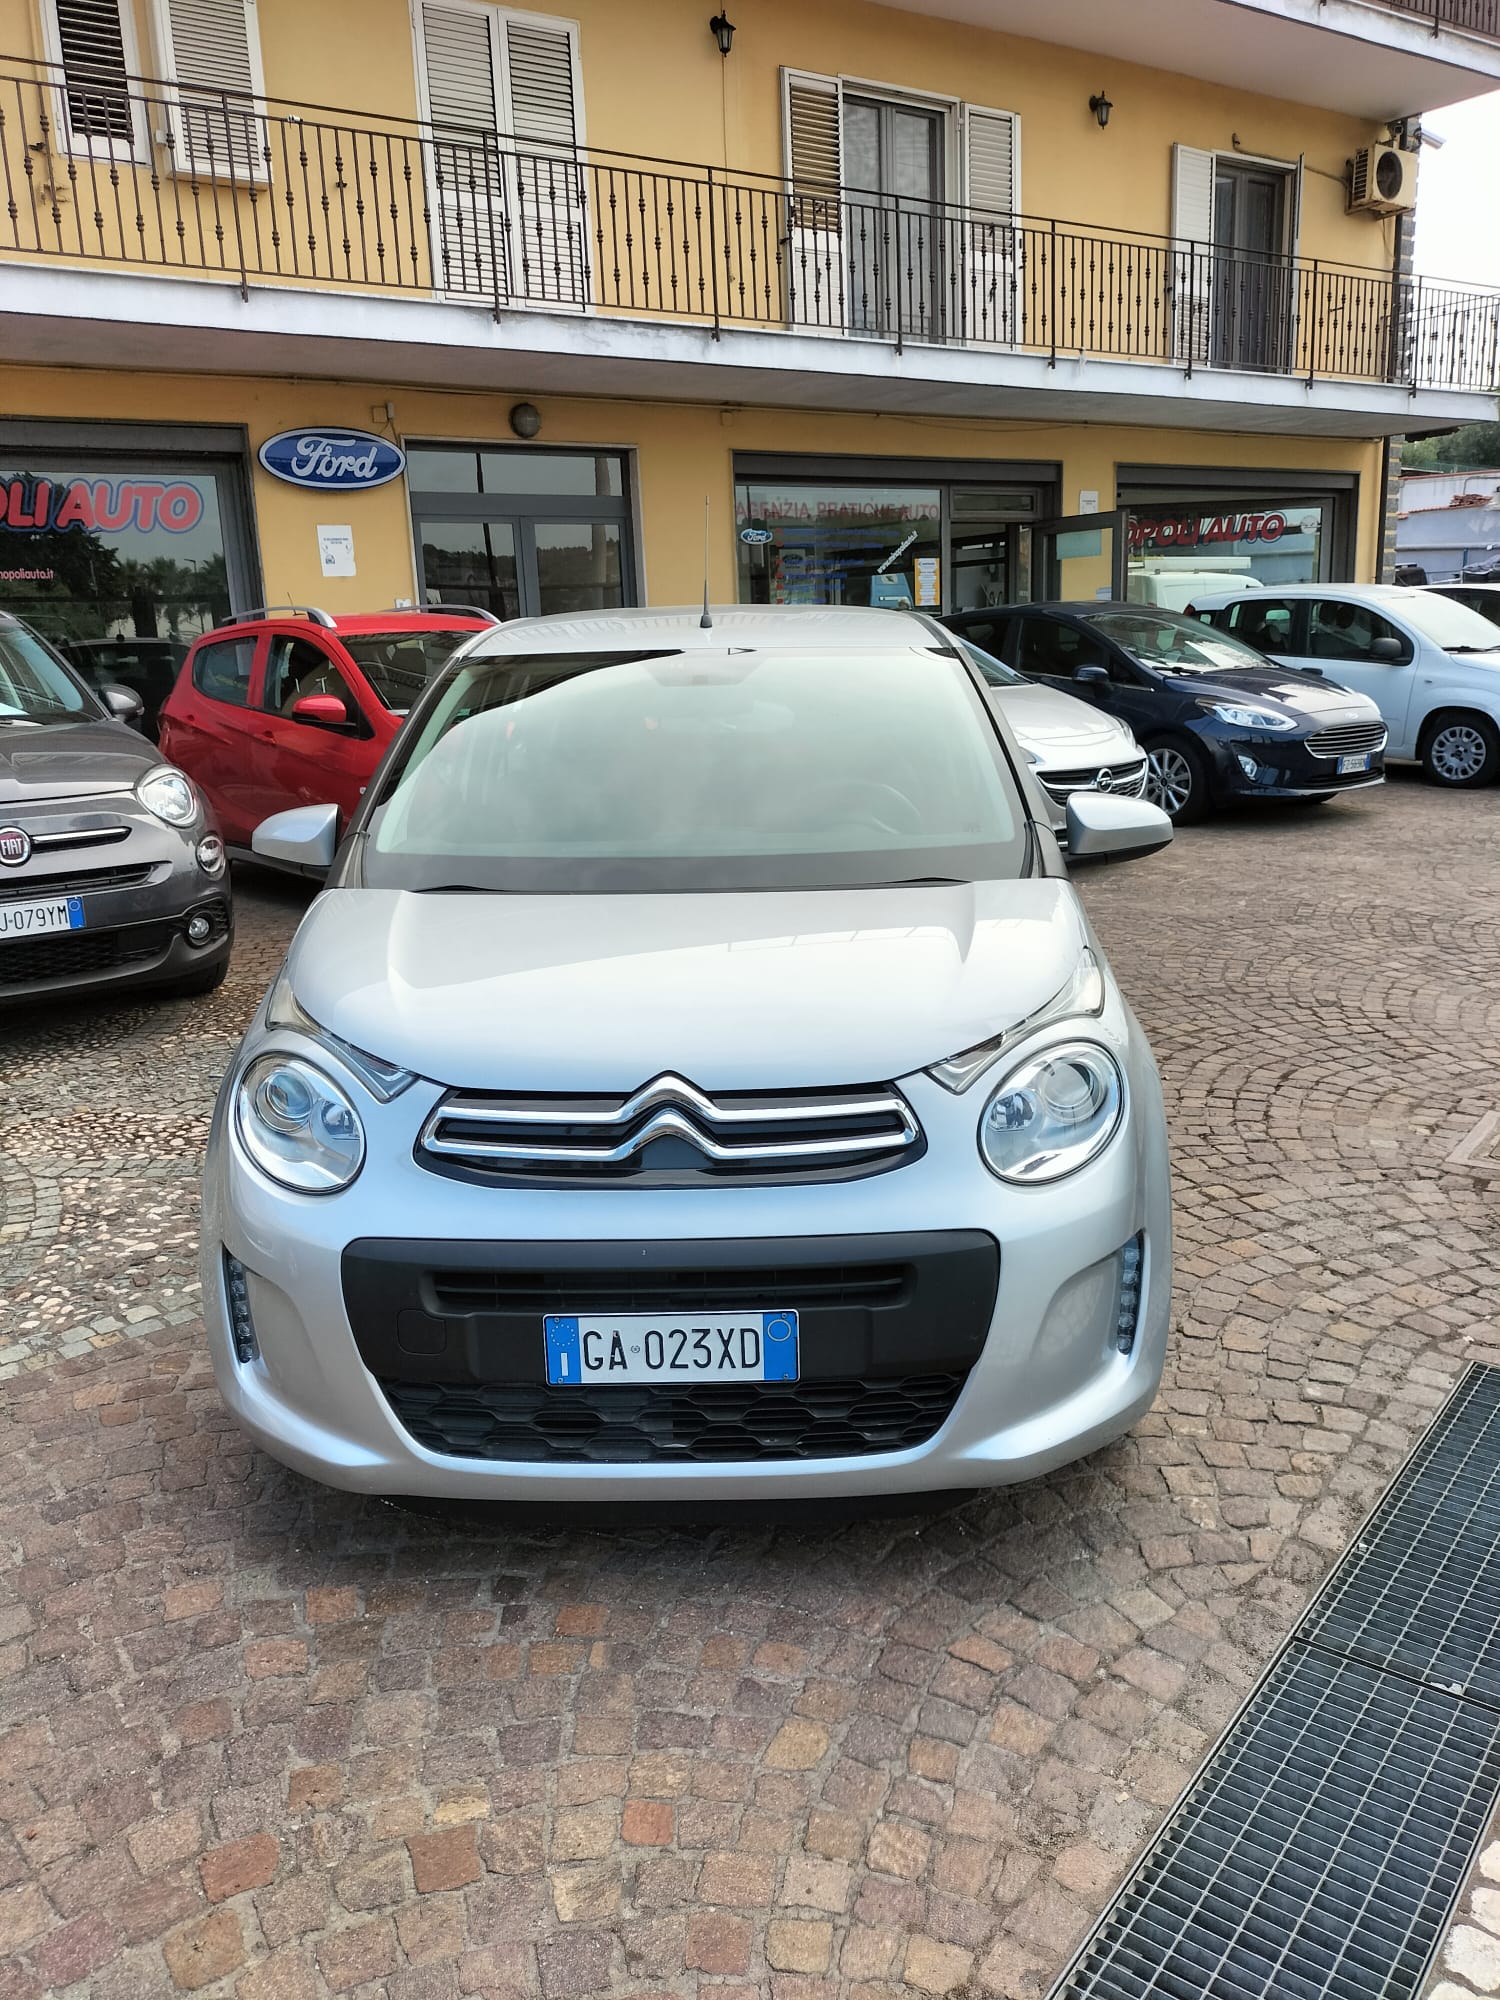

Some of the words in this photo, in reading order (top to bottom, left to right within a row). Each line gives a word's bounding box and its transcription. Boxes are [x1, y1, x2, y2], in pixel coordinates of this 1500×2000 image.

[291, 436, 377, 478] Ford
[56, 482, 201, 530] AUTO
[736, 502, 809, 519] AGENZIA
[902, 504, 938, 520] AUTO
[1204, 515, 1285, 542] AUTO
[1, 838, 23, 856] FIAT
[14, 904, 68, 930] 079YM
[583, 1330, 627, 1370] GA
[645, 1328, 760, 1369] 023XD
[561, 1352, 569, 1377] I
